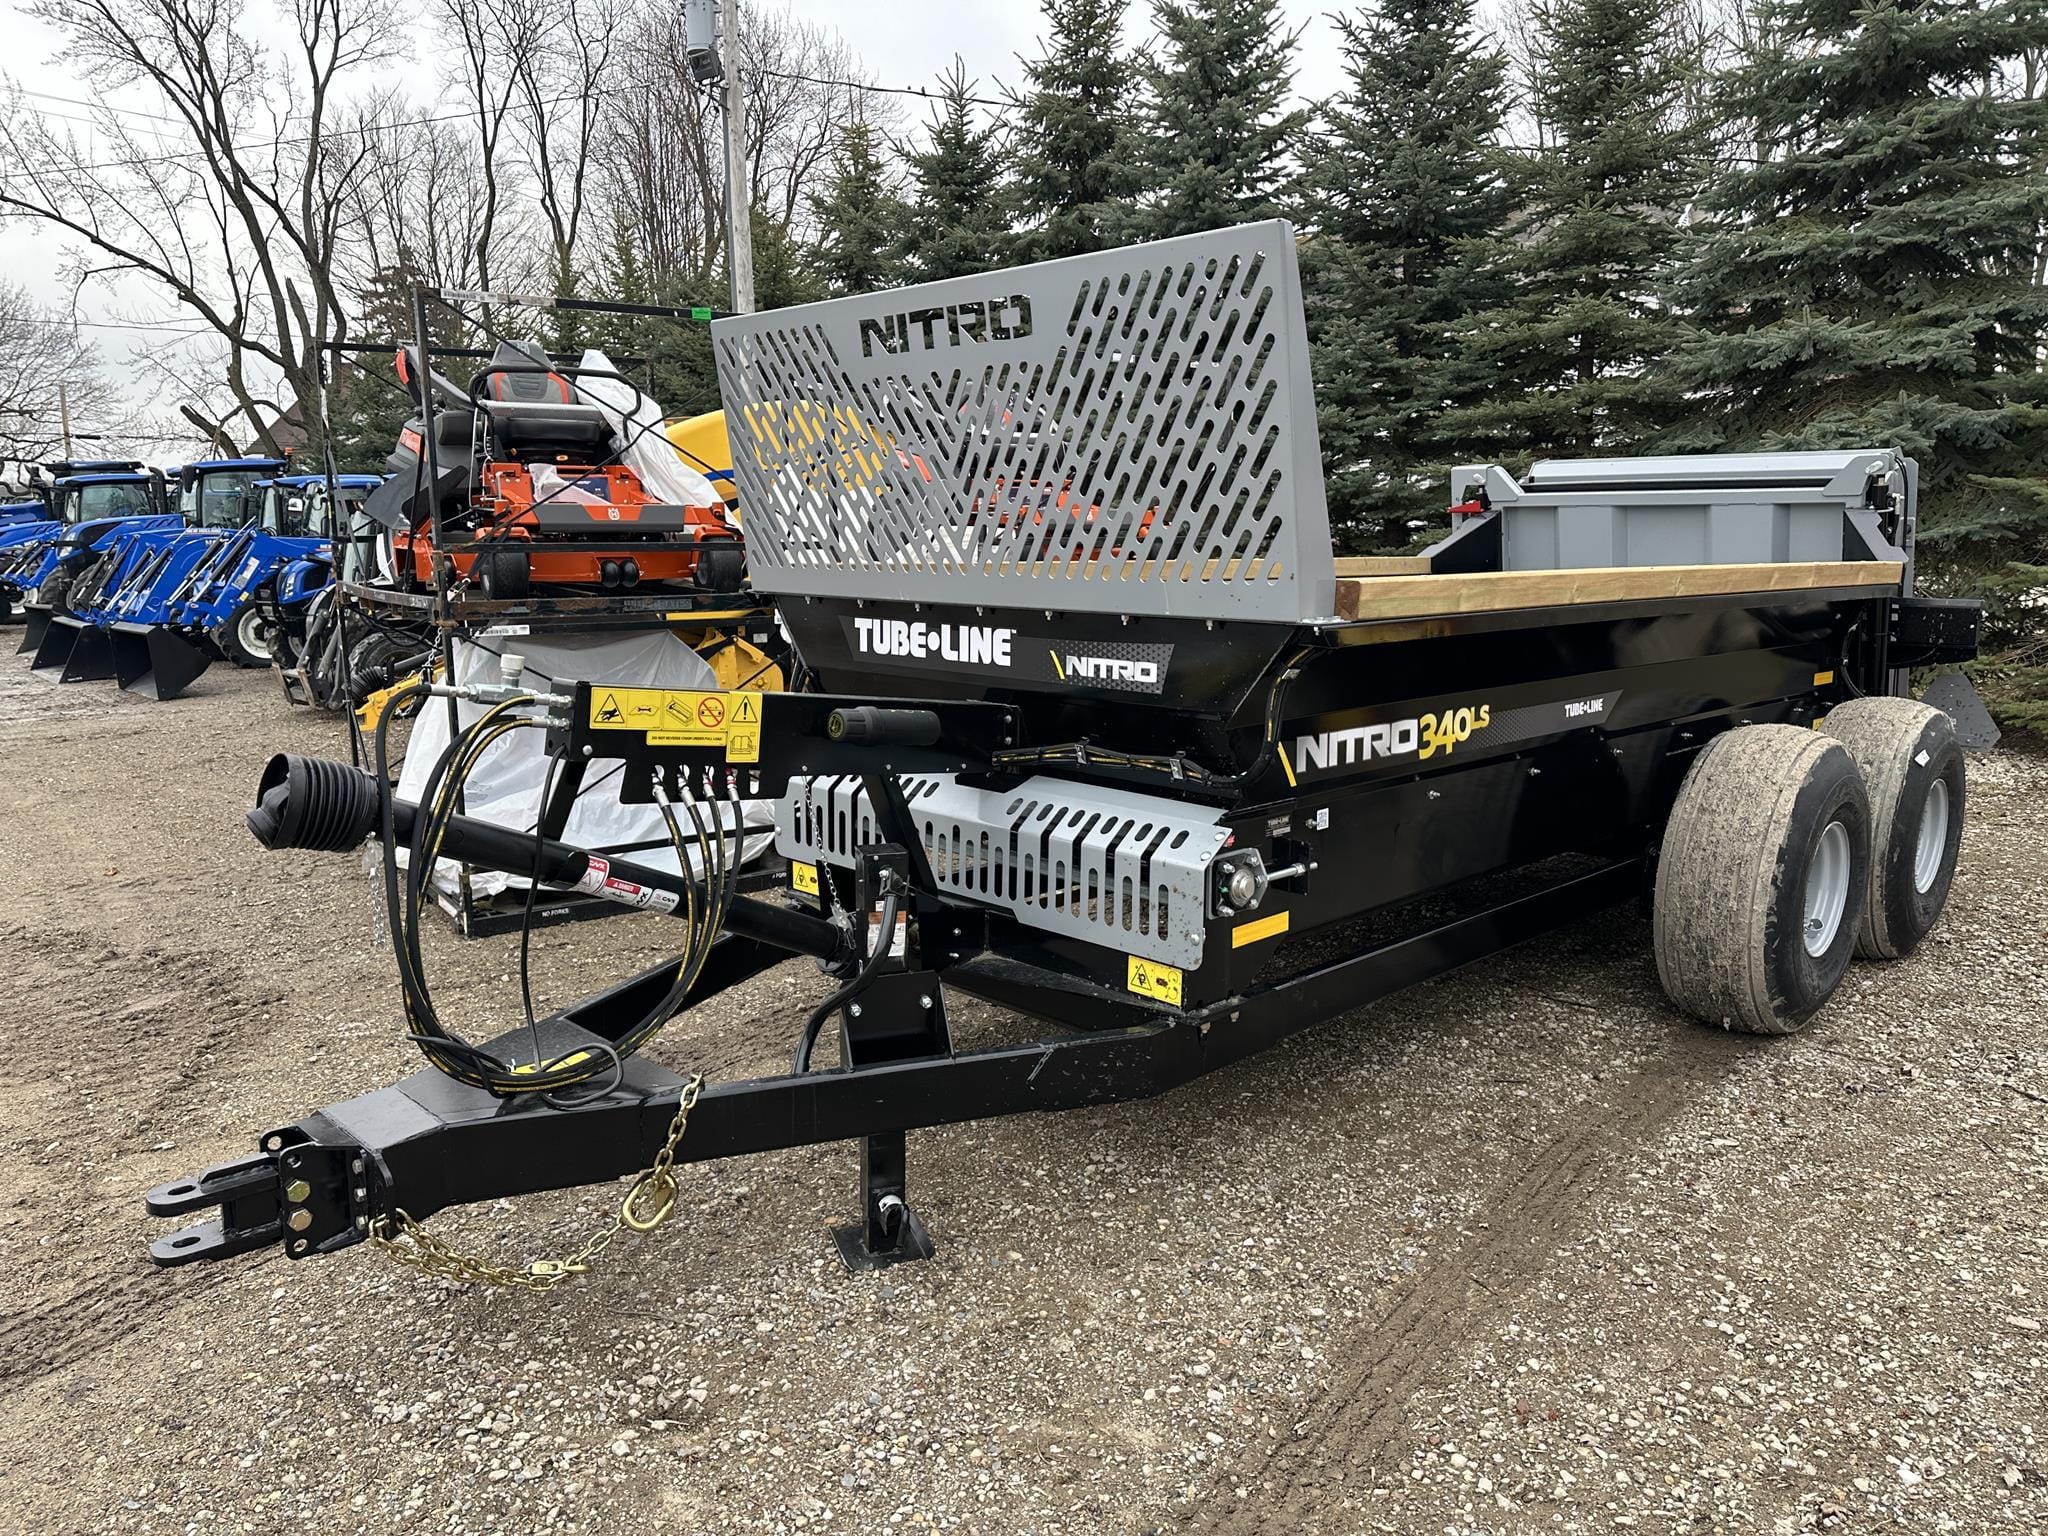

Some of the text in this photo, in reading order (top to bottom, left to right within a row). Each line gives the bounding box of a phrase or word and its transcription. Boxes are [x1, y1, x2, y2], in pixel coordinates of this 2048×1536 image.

[859, 294, 1032, 358] NITRO
[1066, 655, 1158, 684] NITRO
[1296, 718, 1418, 773] NITRO
